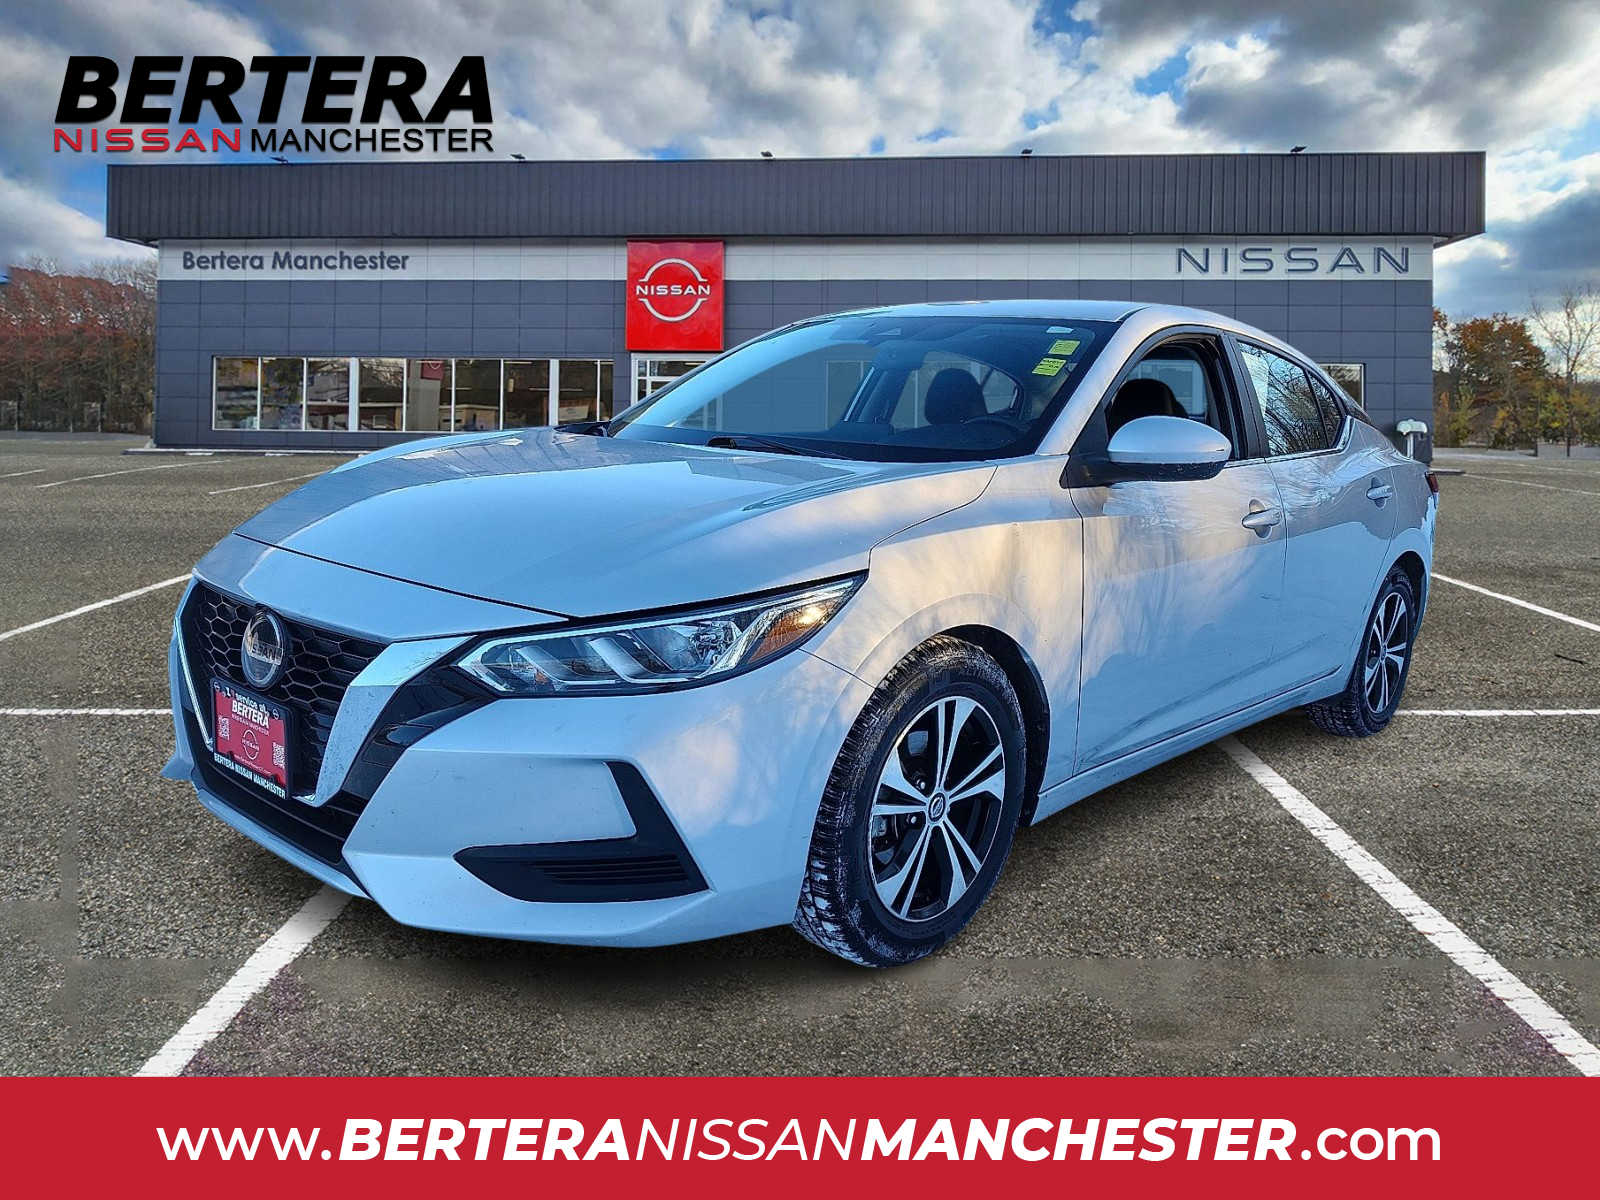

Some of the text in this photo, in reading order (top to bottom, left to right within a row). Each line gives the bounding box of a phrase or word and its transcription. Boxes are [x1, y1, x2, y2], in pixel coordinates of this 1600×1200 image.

[182, 250, 410, 270] Bertera Manchester
[1177, 247, 1409, 274] NISSAN
[635, 284, 711, 296] NISSAN
[231, 699, 270, 729] BERTERA
[213, 752, 235, 771] BERTERA
[234, 762, 253, 781] NISSAN
[252, 772, 286, 799] MANCHESTER
